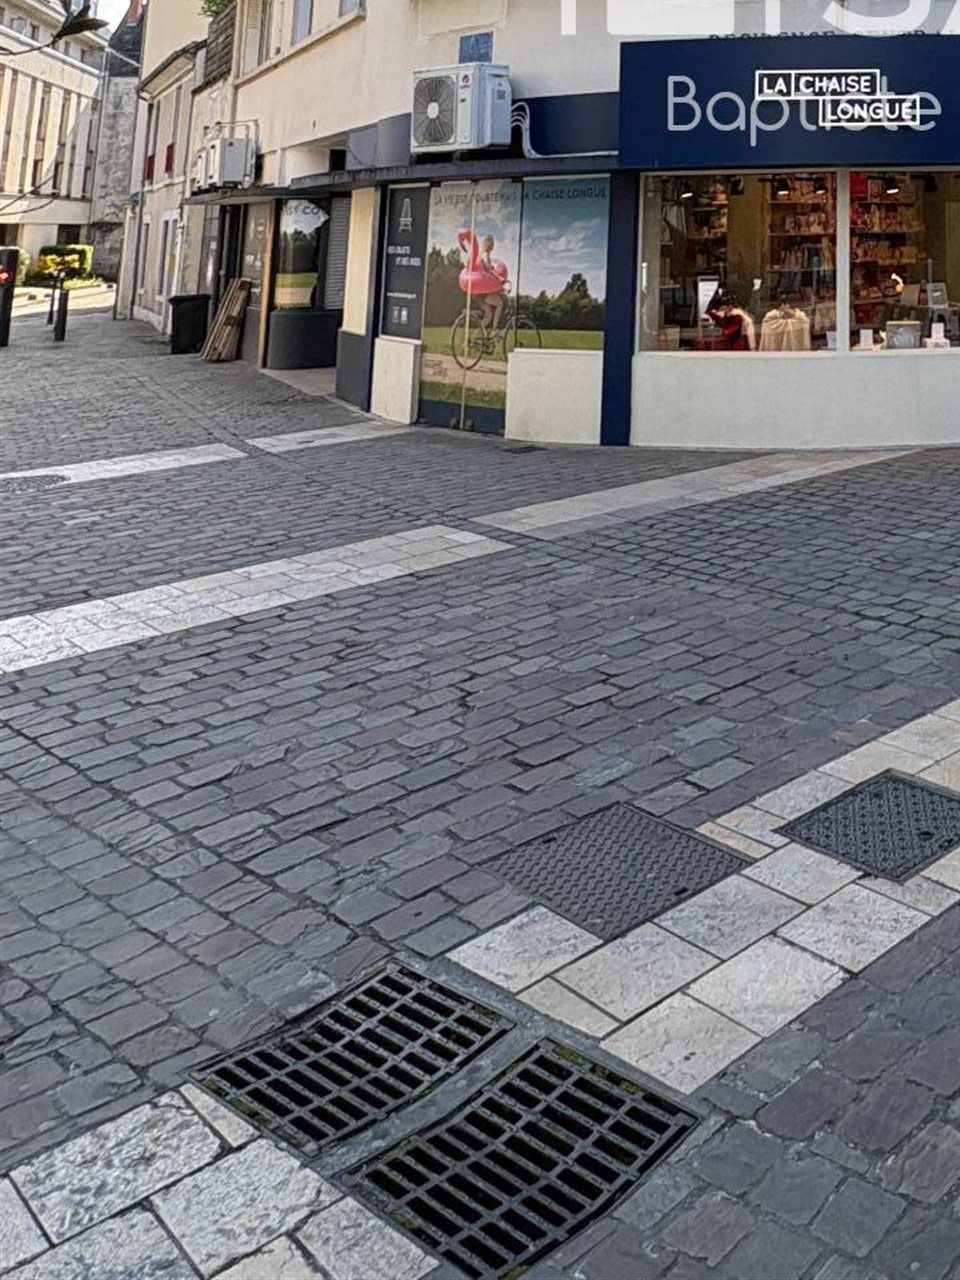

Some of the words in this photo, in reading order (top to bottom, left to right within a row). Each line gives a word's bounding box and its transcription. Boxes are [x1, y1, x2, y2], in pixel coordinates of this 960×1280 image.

[763, 76, 787, 94] LA
[799, 75, 871, 93] CHAISE
[827, 101, 913, 120] LONGUE
[567, 186, 607, 200] LONGUE
